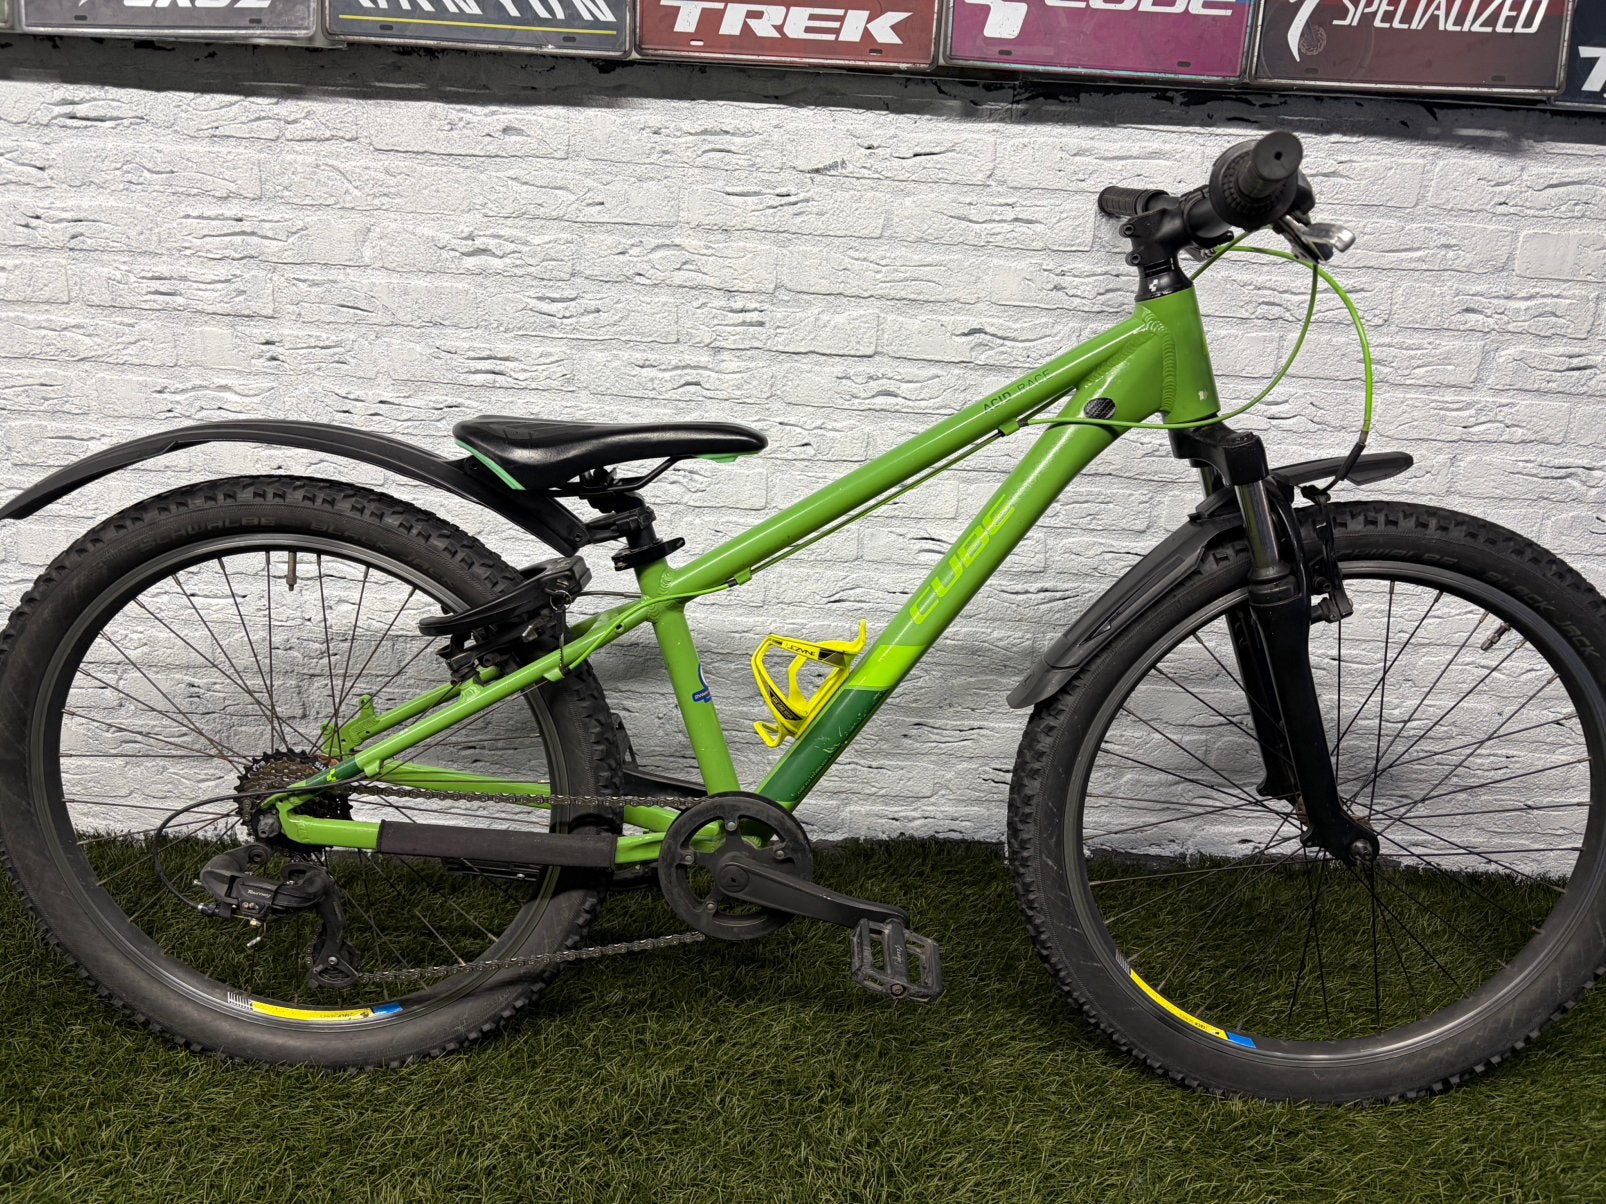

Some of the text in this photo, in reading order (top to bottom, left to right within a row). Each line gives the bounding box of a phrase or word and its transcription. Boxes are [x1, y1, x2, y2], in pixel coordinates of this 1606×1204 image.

[659, 0, 914, 44] TREK
[1332, 0, 1547, 34] SPECIALIZED
[909, 494, 1016, 625] CUBE
